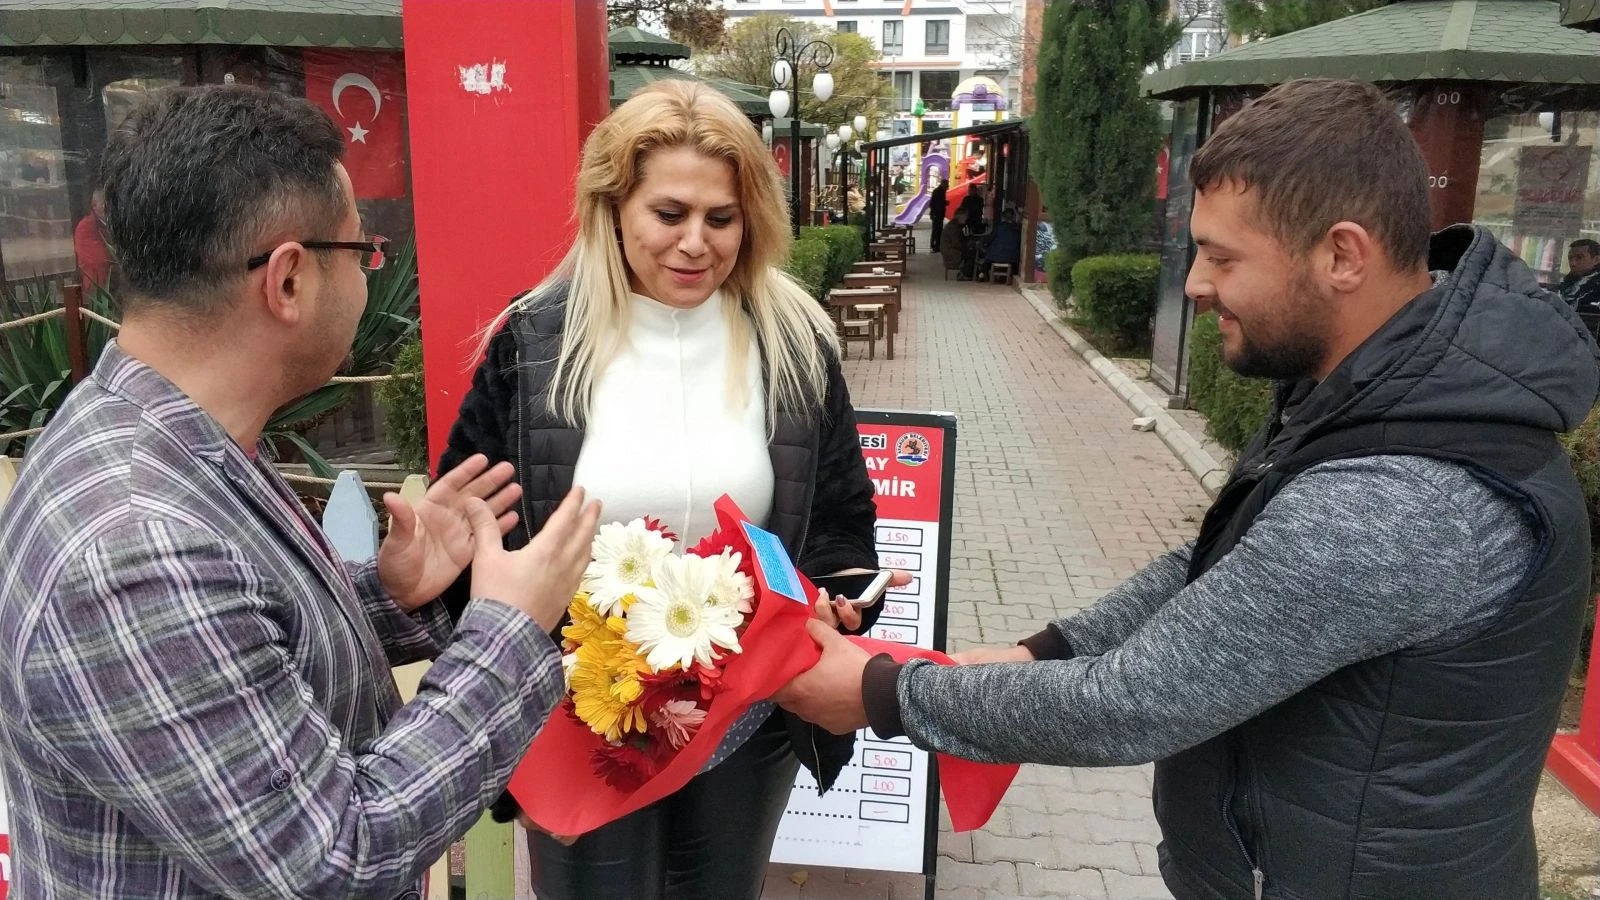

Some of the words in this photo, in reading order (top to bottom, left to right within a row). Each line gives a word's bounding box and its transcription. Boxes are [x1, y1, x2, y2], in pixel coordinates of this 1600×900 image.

[860, 434, 885, 448] ESİ
[865, 456, 889, 471] AY
[872, 475, 916, 497] MİR
